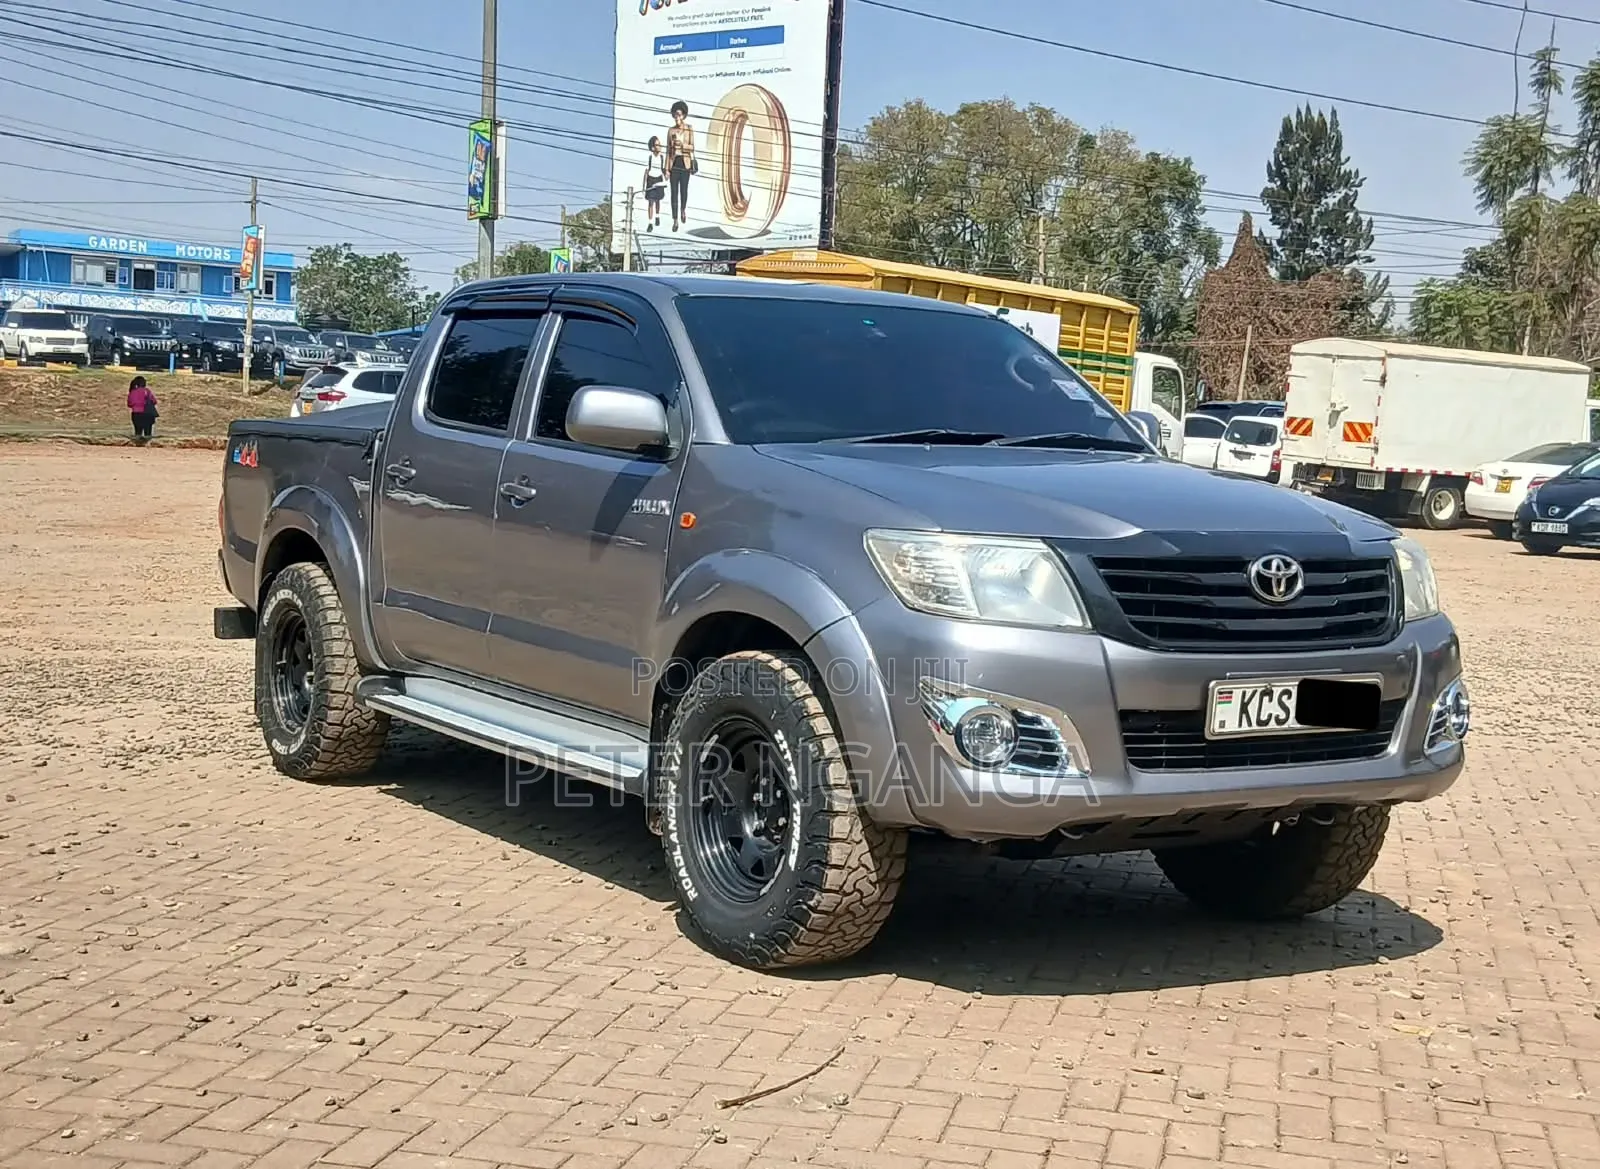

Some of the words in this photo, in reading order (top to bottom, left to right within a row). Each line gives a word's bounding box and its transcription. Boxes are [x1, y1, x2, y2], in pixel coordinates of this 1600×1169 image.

[659, 42, 683, 51] Amount
[729, 37, 747, 45] Rates
[88, 235, 148, 253] GARDEN
[175, 244, 231, 260] MOTORS
[1237, 687, 1293, 729] KCS
[667, 780, 699, 902] ROADLANDER
